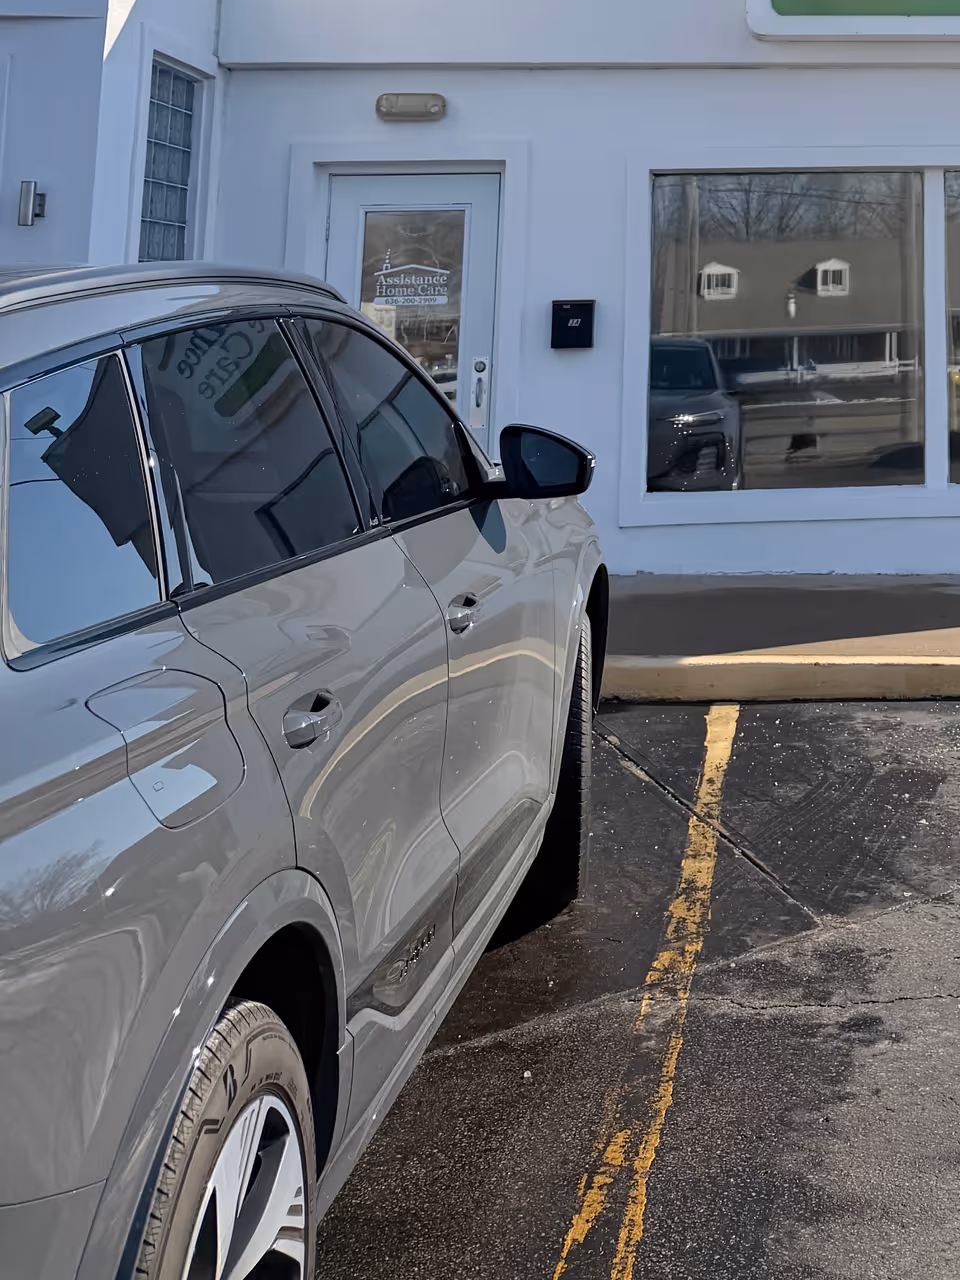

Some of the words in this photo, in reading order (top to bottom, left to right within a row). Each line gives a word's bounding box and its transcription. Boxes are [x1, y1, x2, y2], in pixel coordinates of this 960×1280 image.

[376, 274, 448, 285] Assistance
[376, 285, 415, 296] Home
[418, 285, 448, 296] Care
